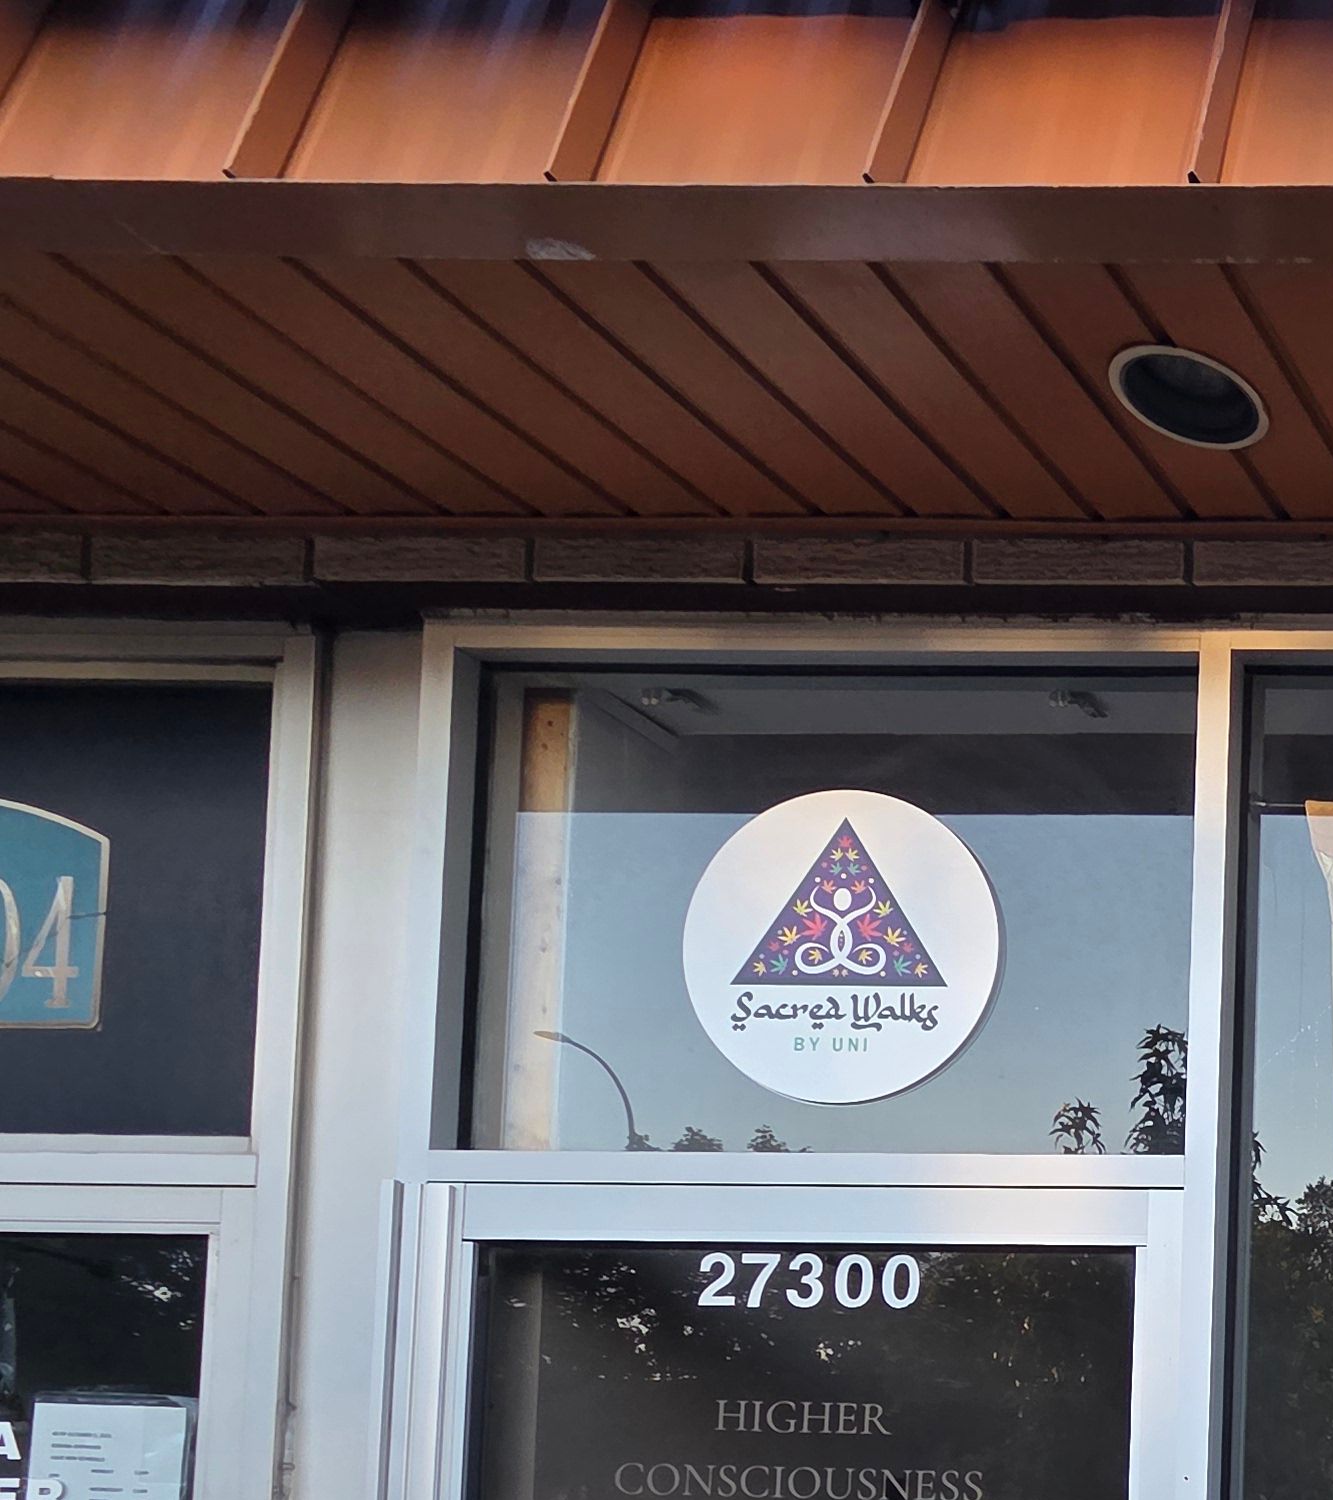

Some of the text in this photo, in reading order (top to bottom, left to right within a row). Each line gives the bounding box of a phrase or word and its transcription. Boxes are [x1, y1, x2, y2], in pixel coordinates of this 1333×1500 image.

[731, 991, 939, 1031] Sacred Walks
[794, 1037, 868, 1052] BY UNI
[697, 1251, 921, 1310] 27300
[714, 1399, 893, 1435] HIGHER
